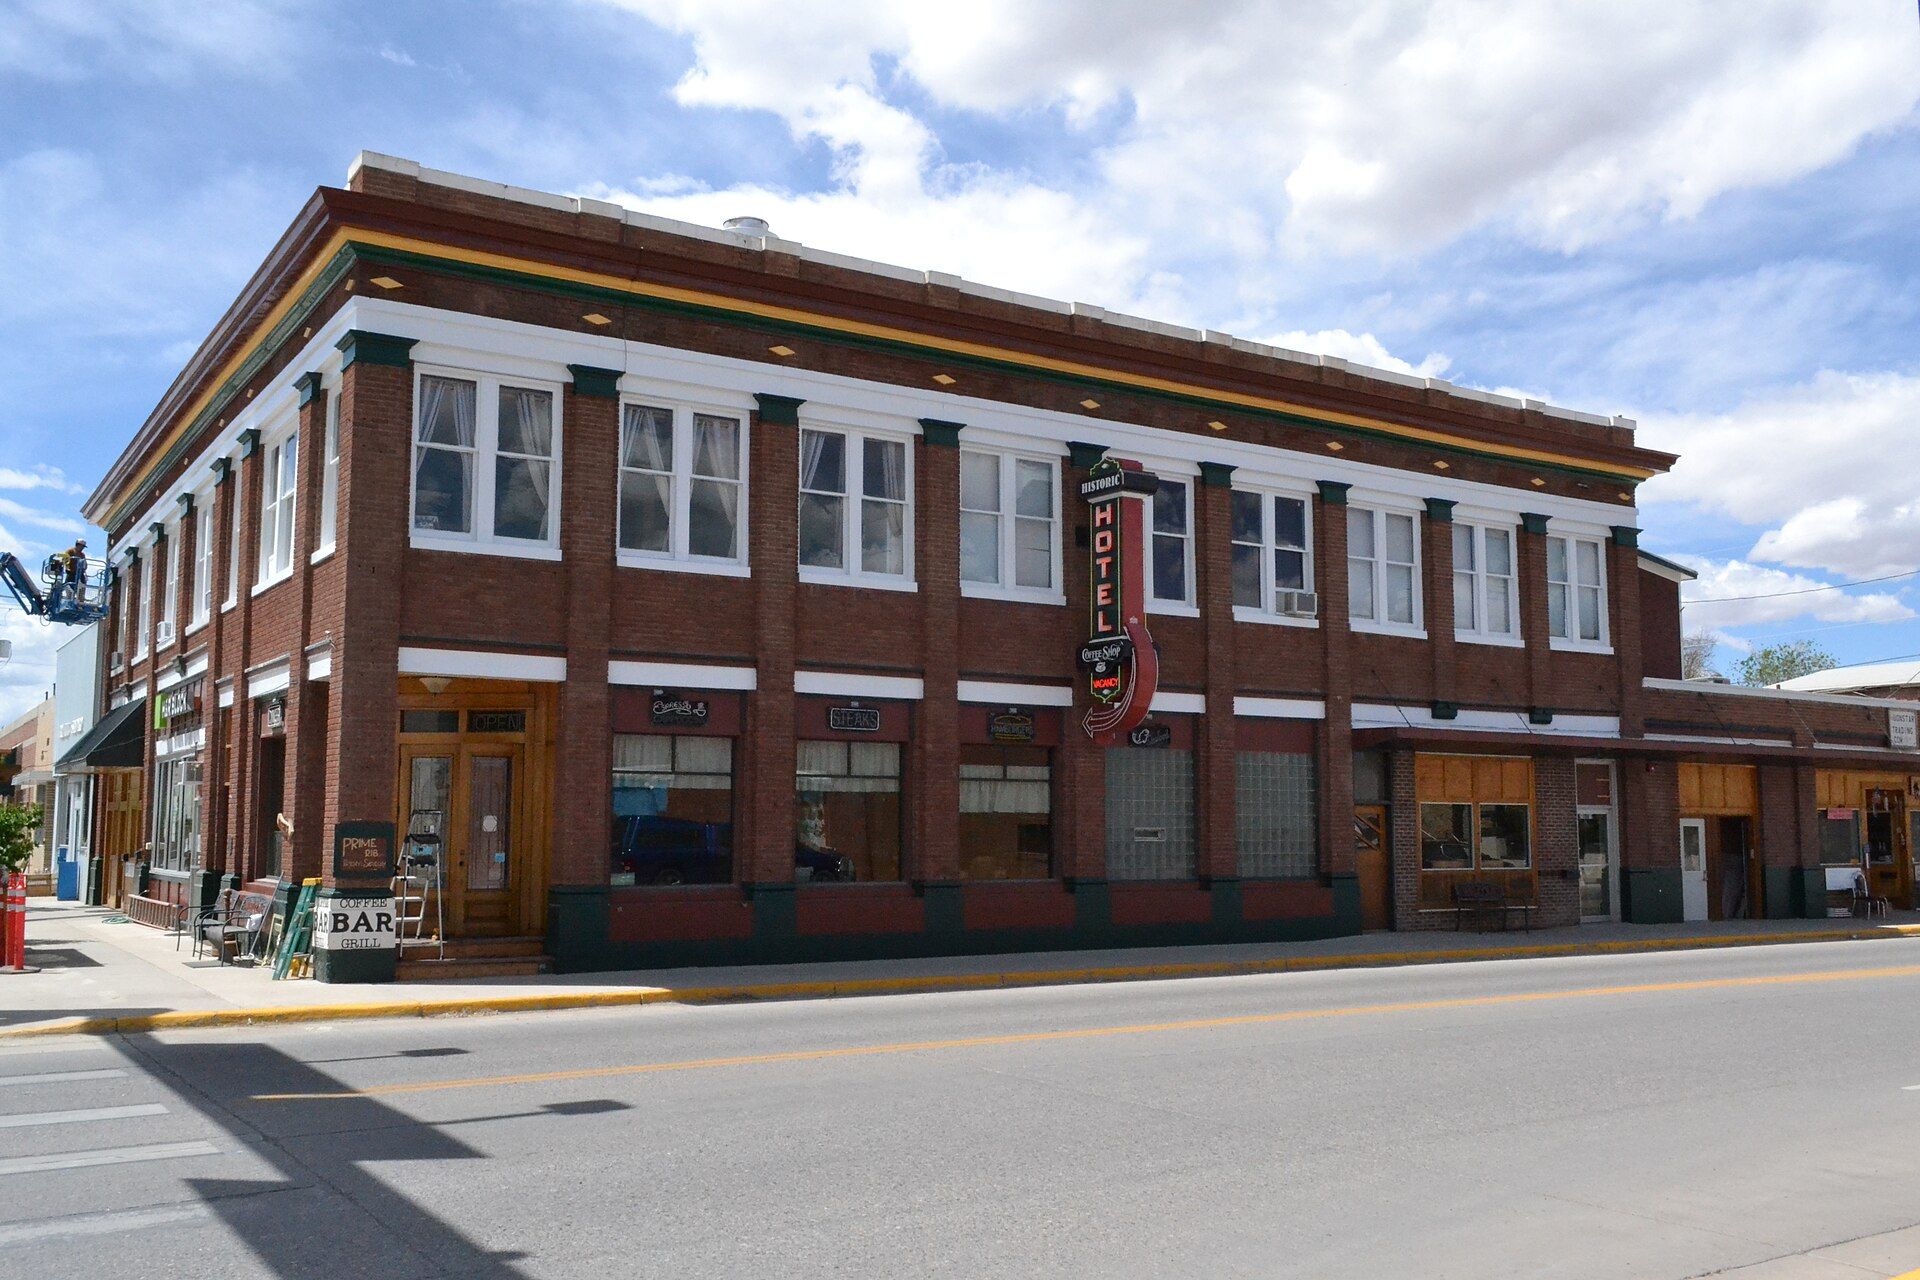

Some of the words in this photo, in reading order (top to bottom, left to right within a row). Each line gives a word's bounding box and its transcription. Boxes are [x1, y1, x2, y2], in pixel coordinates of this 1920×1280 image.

[1081, 474, 1120, 494] HISTORIC
[1095, 503, 1113, 633] HOTEL
[1092, 676, 1119, 689] VACANCY
[475, 714, 520, 731] OPEN
[833, 709, 877, 728] STEAKS
[342, 837, 378, 858] PRIME
[364, 849, 379, 858] RIB
[340, 898, 388, 909] COFFEE
[331, 911, 394, 933] BAR
[341, 938, 381, 949] GRILL
